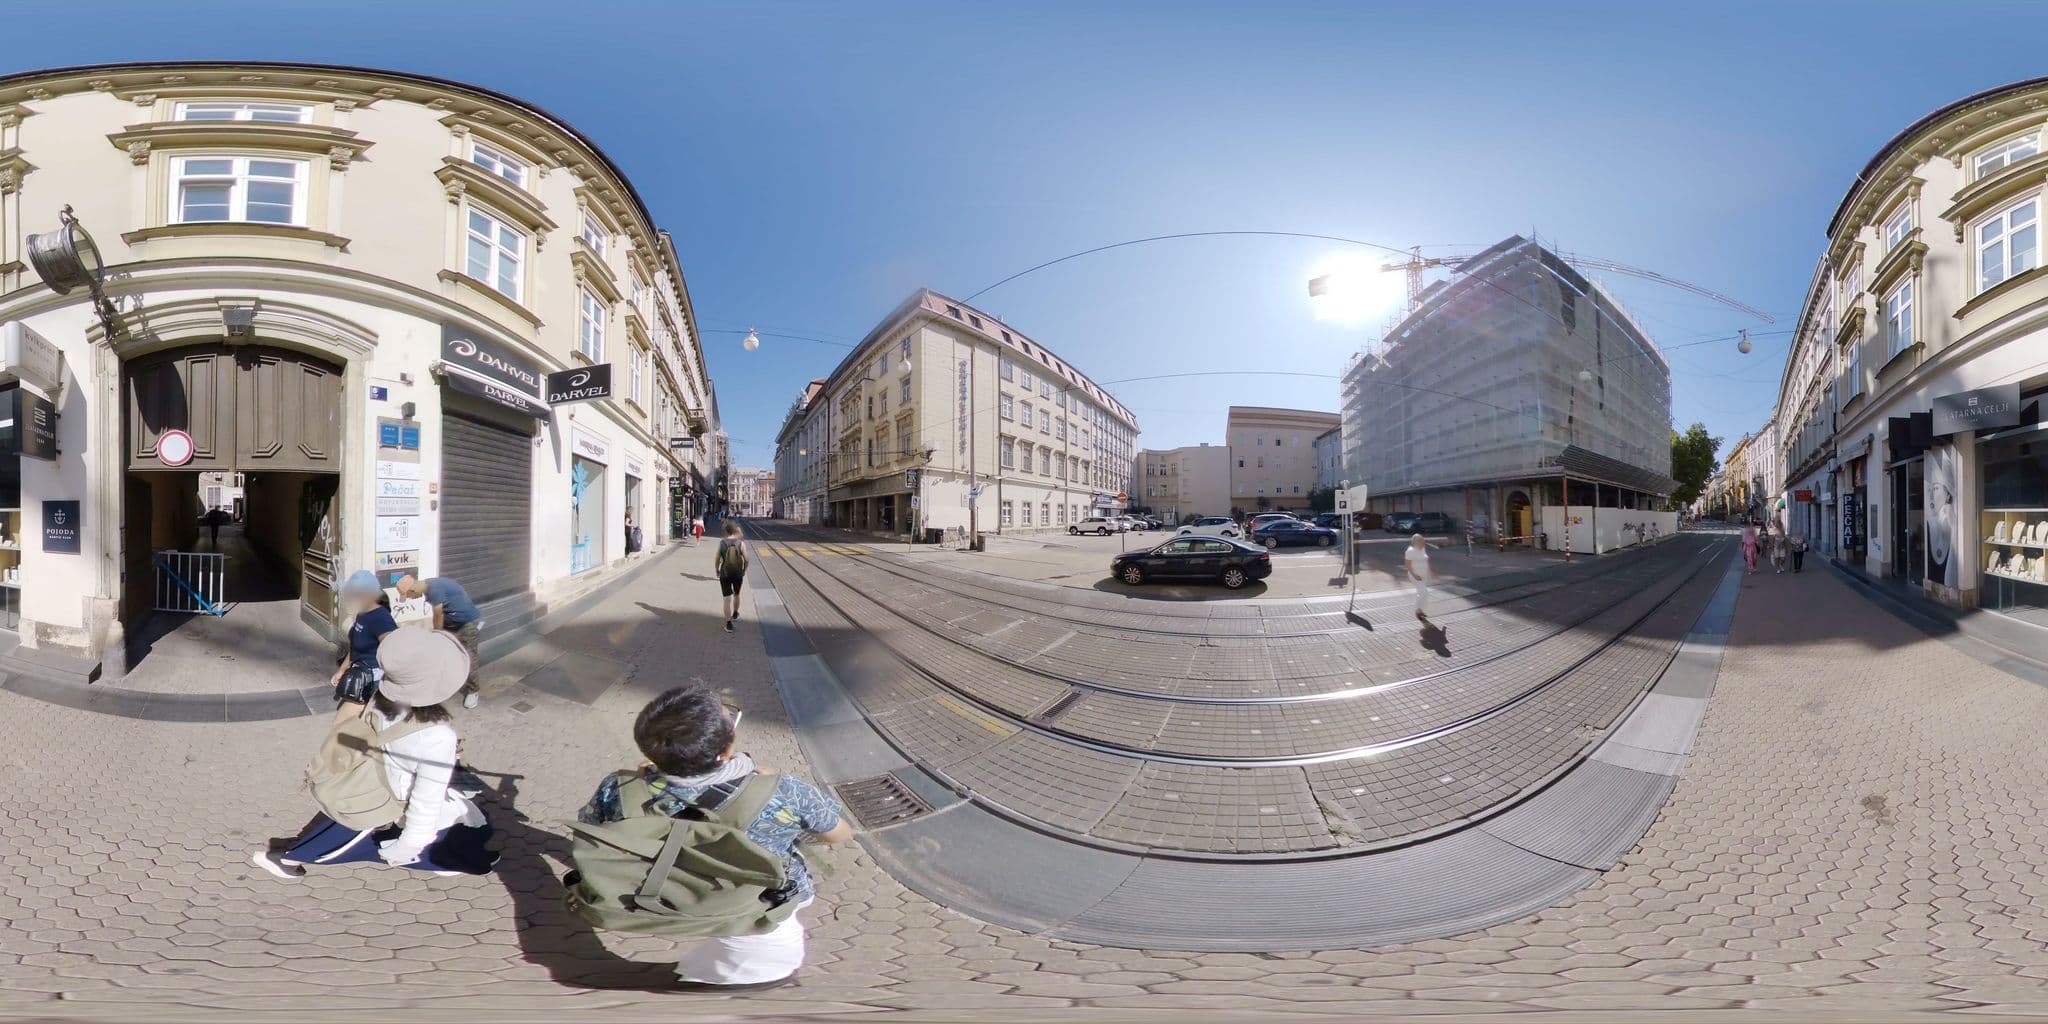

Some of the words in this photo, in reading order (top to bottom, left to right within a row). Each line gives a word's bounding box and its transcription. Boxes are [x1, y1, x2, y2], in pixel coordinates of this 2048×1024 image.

[478, 350, 538, 388] DARVEL
[484, 385, 529, 408] DARVEL
[550, 386, 608, 402] DARVEL
[387, 553, 409, 565] kvik
